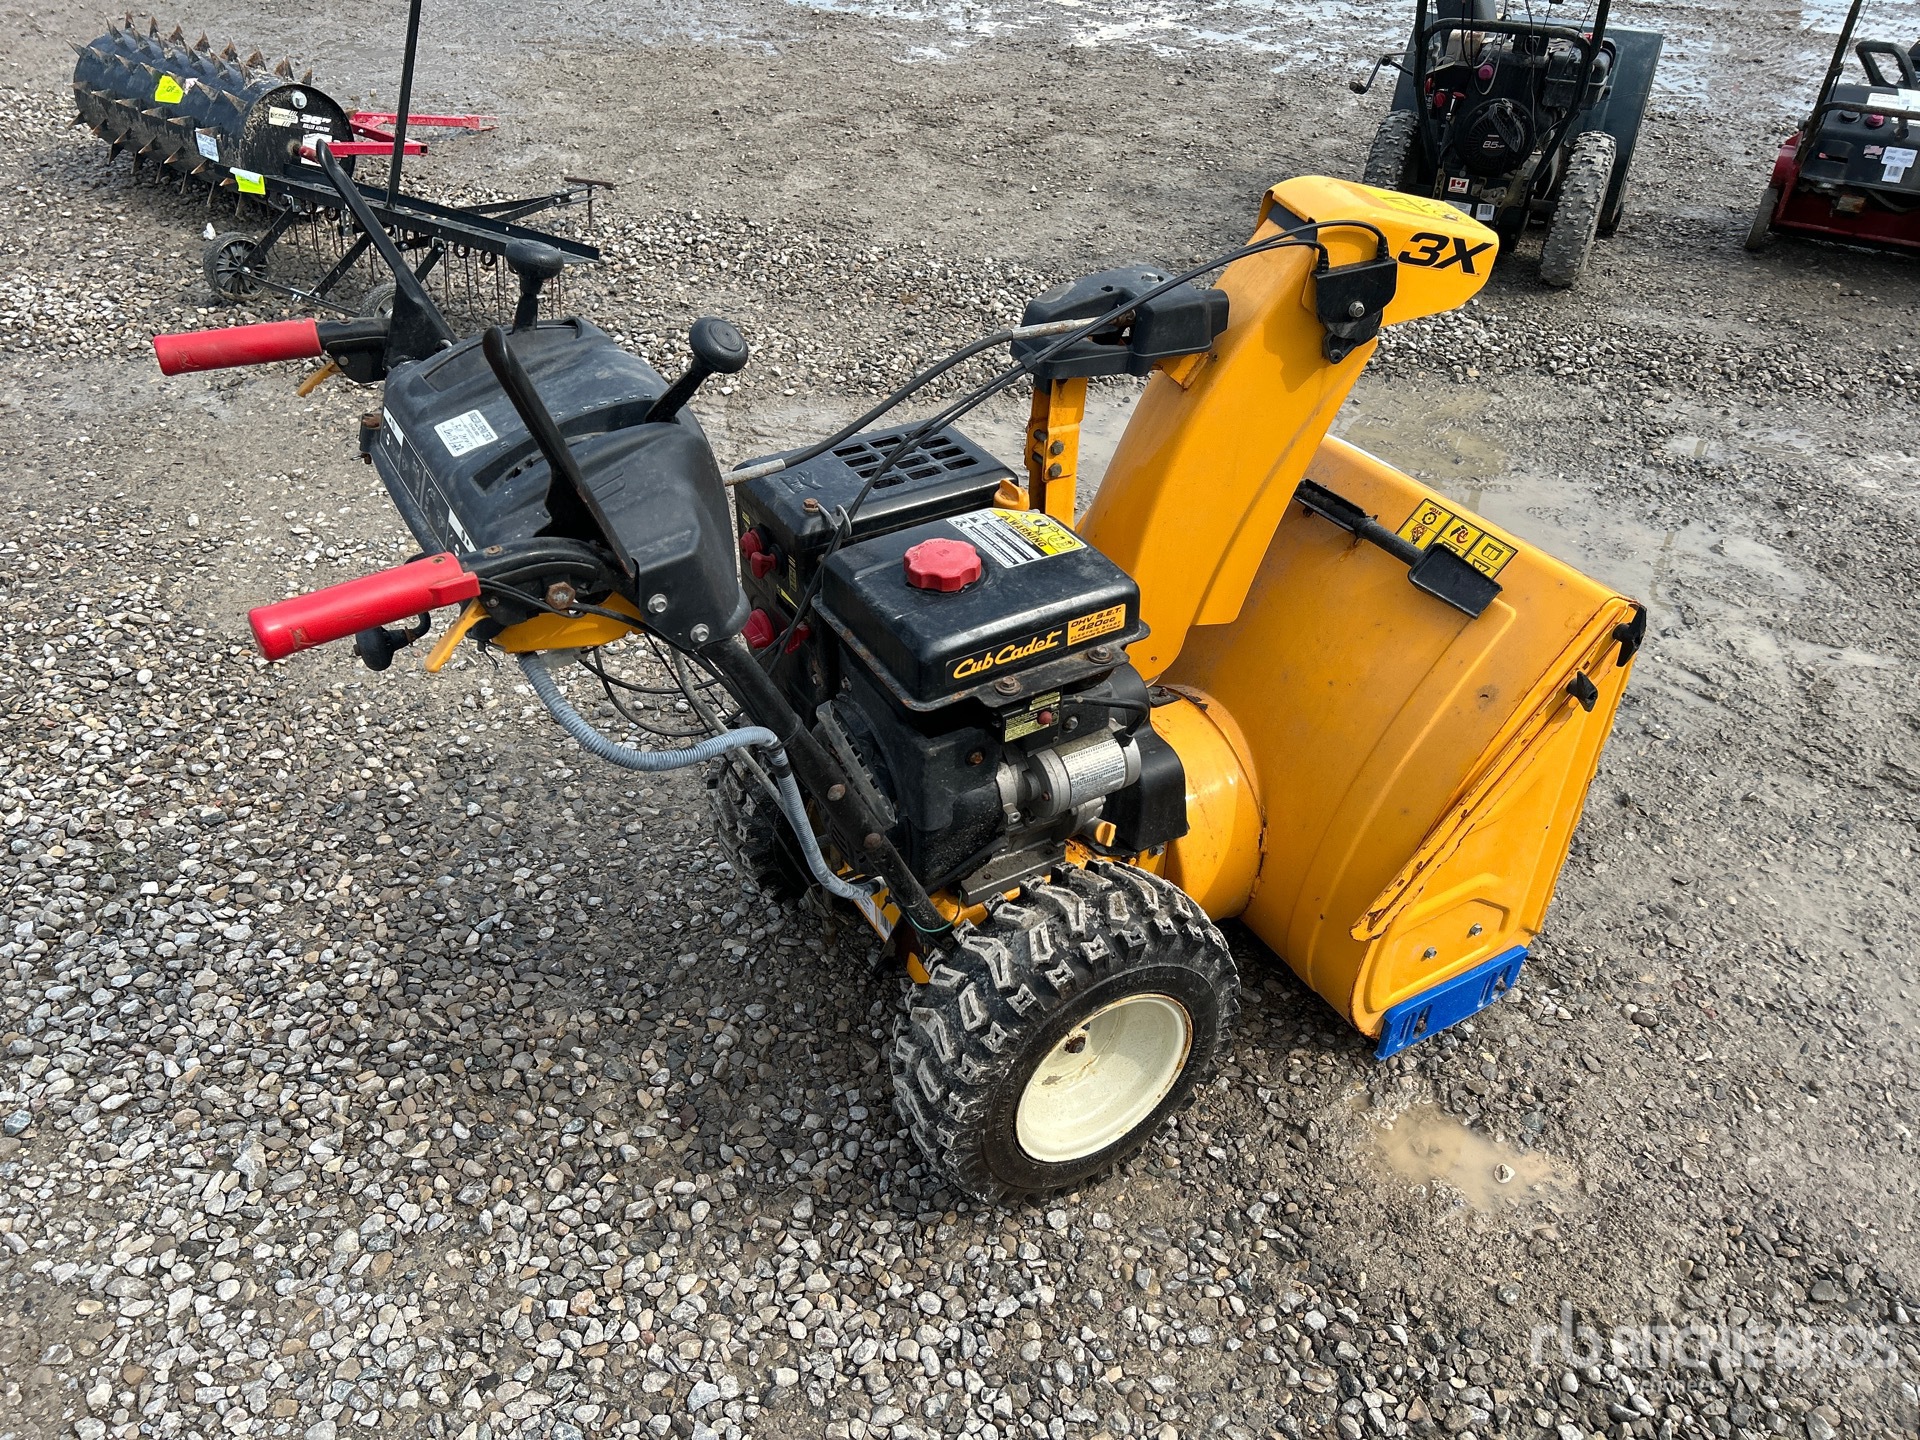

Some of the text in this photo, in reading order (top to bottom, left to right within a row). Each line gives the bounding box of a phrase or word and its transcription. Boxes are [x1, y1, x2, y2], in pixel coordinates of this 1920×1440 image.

[1398, 232, 1494, 274] 3X
[1009, 519, 1047, 548] WARNING
[1071, 616, 1094, 627] OHV
[1078, 617, 1116, 631] 420cc
[953, 653, 994, 679] Cub
[995, 630, 1062, 664] Cadet
